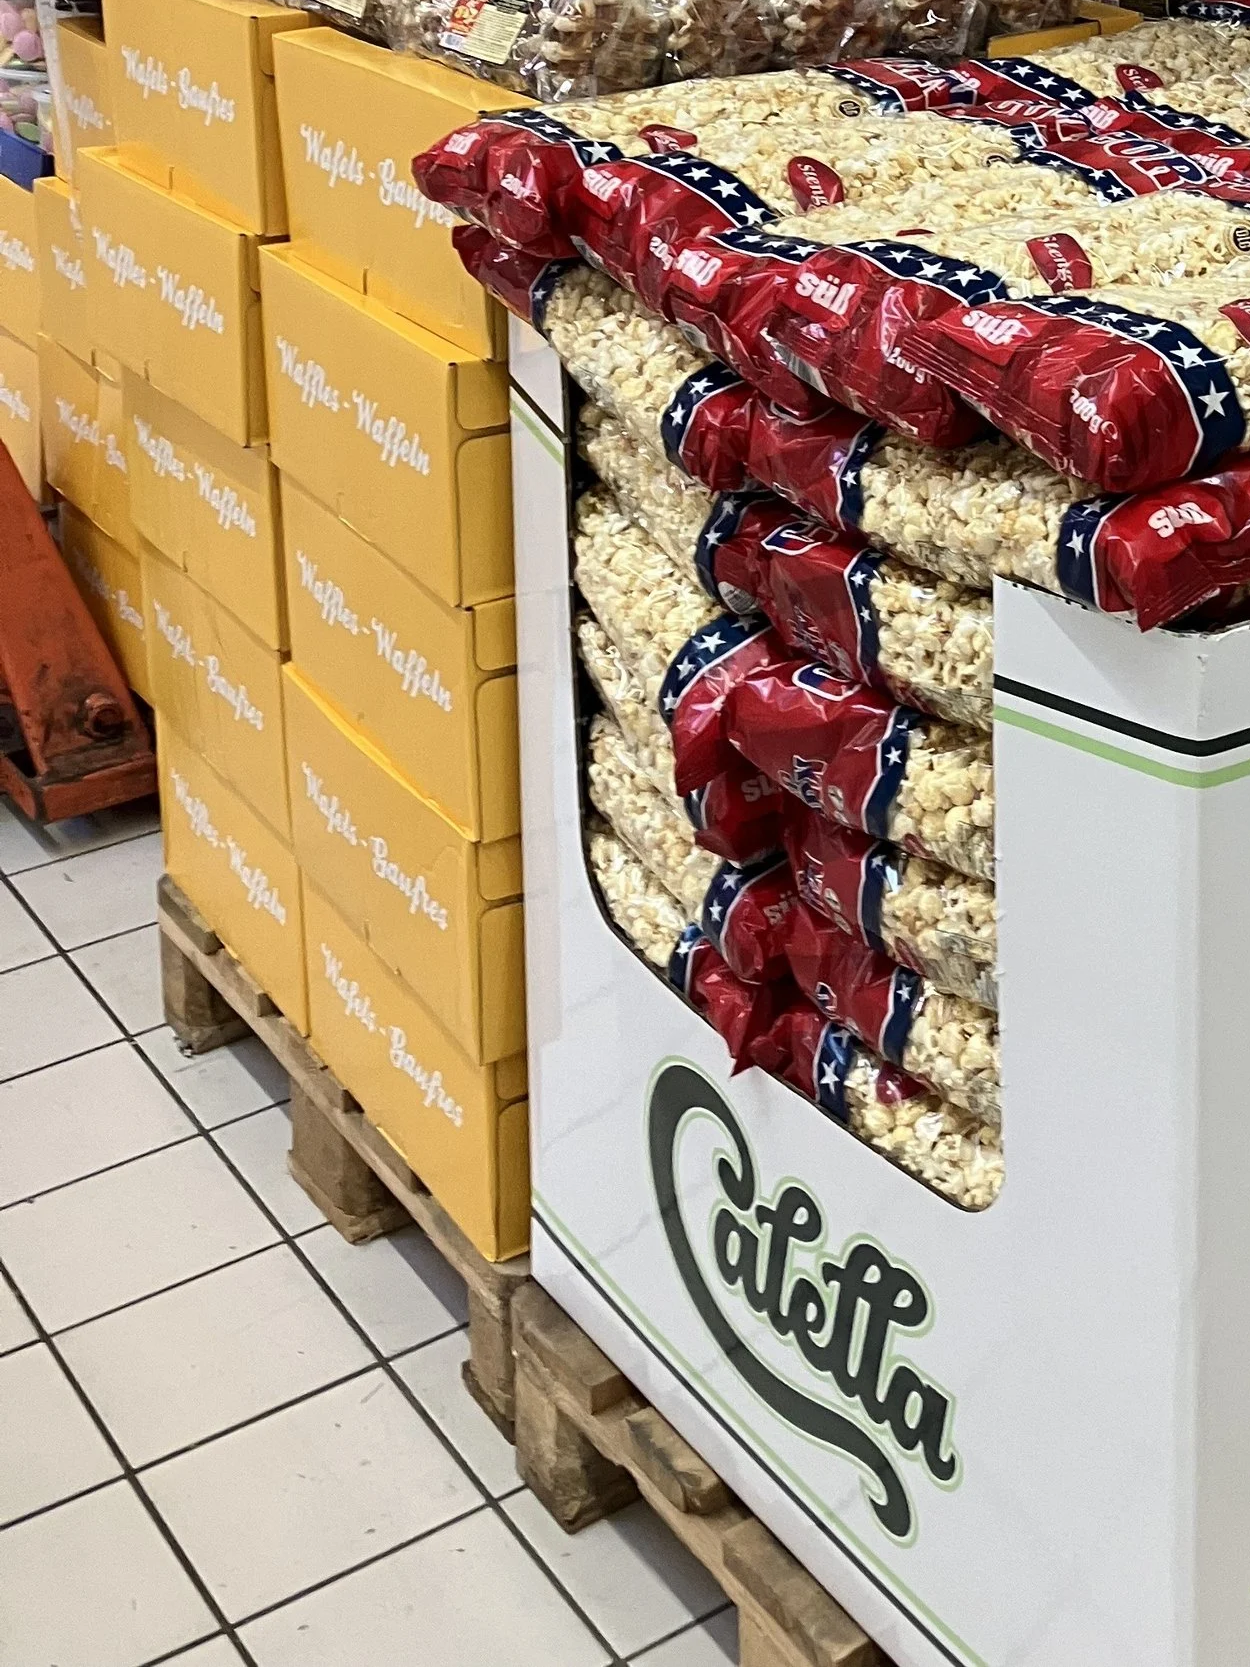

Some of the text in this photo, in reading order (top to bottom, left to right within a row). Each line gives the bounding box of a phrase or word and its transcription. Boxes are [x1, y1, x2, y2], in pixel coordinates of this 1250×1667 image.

[122, 46, 168, 99] Wafels
[300, 124, 365, 188] Wafels
[92, 226, 147, 288] Waffles
[157, 266, 224, 334] Waffeln
[795, 272, 858, 315] süß
[275, 335, 340, 413] Waffles
[352, 390, 431, 476] Waffeln
[295, 549, 360, 638] Waffles
[371, 617, 455, 713] Waffeln
[302, 761, 360, 849] Wafels
[371, 836, 449, 931] Gaufres
[322, 941, 379, 1035] Wafels
[388, 1026, 465, 1128] Gaufres
